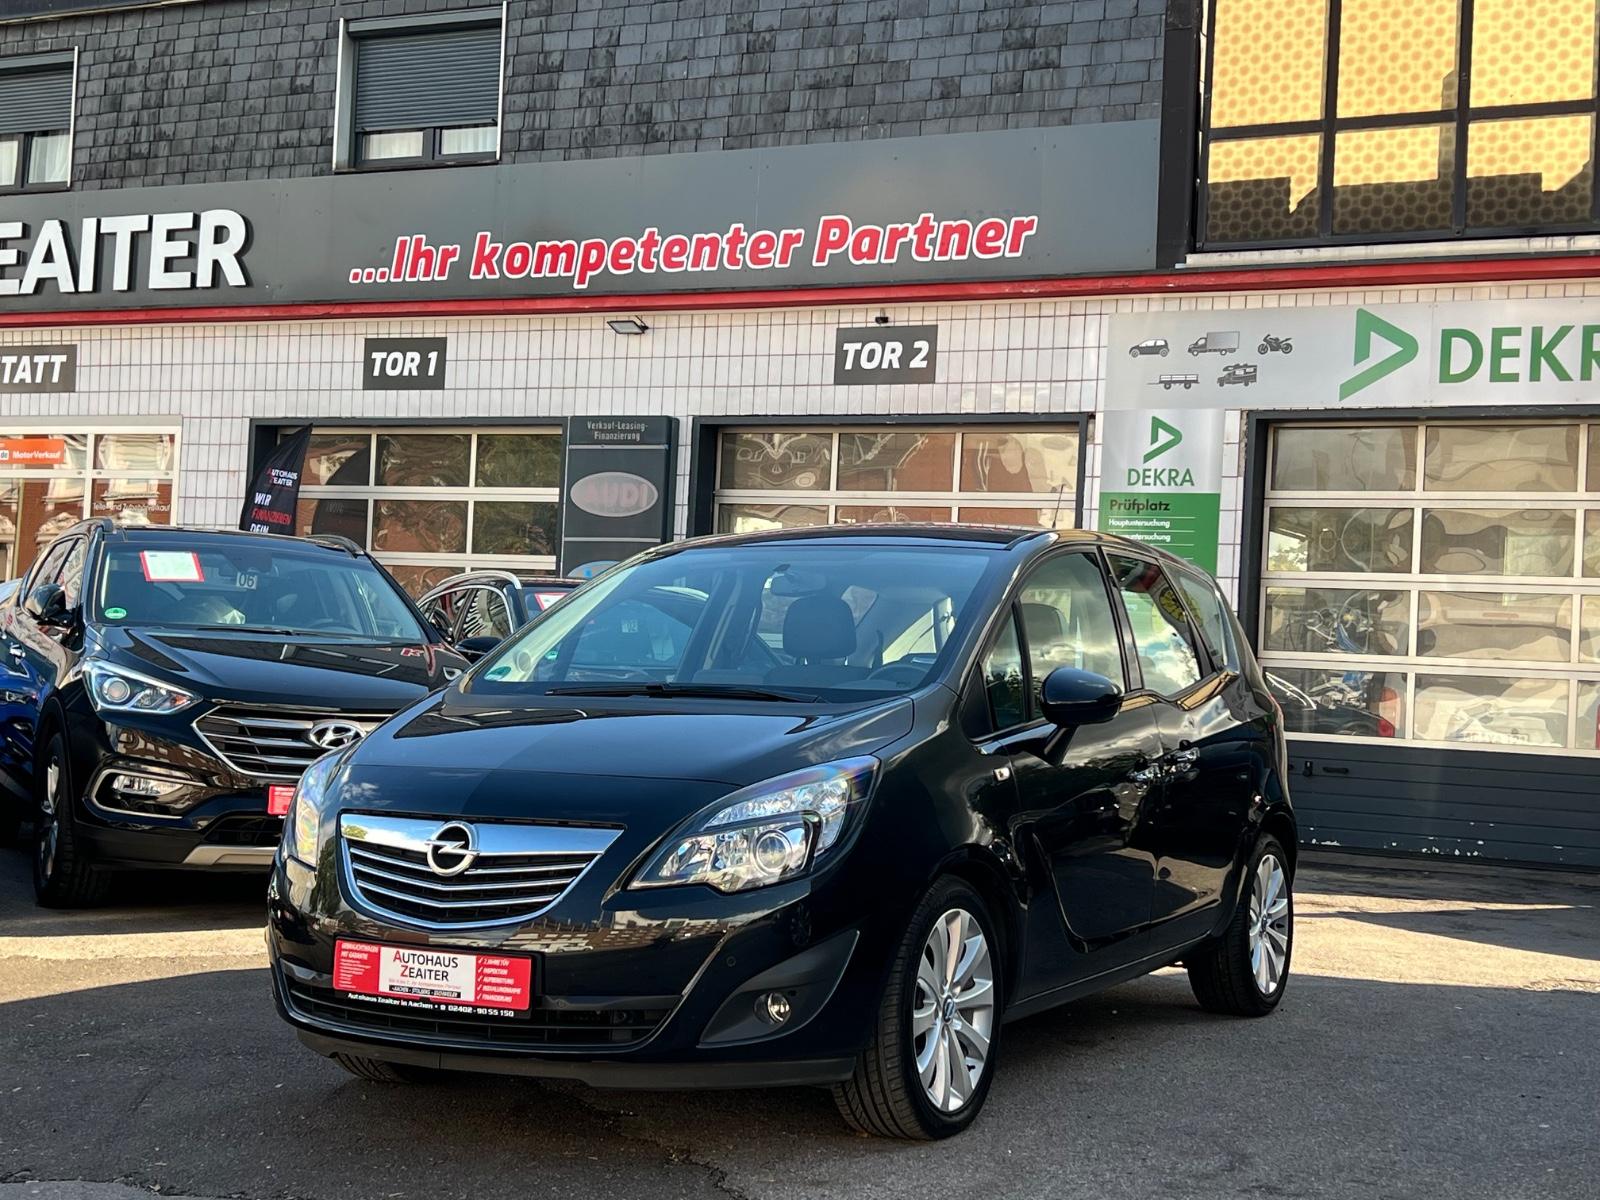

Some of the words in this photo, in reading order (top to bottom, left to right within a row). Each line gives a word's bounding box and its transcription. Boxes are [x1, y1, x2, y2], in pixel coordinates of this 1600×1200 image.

[469, 223, 804, 289] kompetenter
[812, 213, 1038, 267] Partner
[842, 342, 902, 370] TOR
[908, 340, 930, 369] 2
[1438, 324, 1600, 384] DEKR
[371, 352, 419, 377] TOR
[425, 351, 438, 376] 1
[594, 432, 641, 441] Finanzierung
[1127, 468, 1195, 486] DEKRA
[254, 492, 272, 506] WIR
[1109, 499, 1170, 514] Prüfplatz
[1108, 518, 1171, 529] Hauptuntersuchung
[1110, 532, 1172, 543] untersuchung
[393, 950, 459, 968] AUTOHAUS
[400, 965, 449, 981] ZEAITER
[347, 993, 377, 1002] Autohaus
